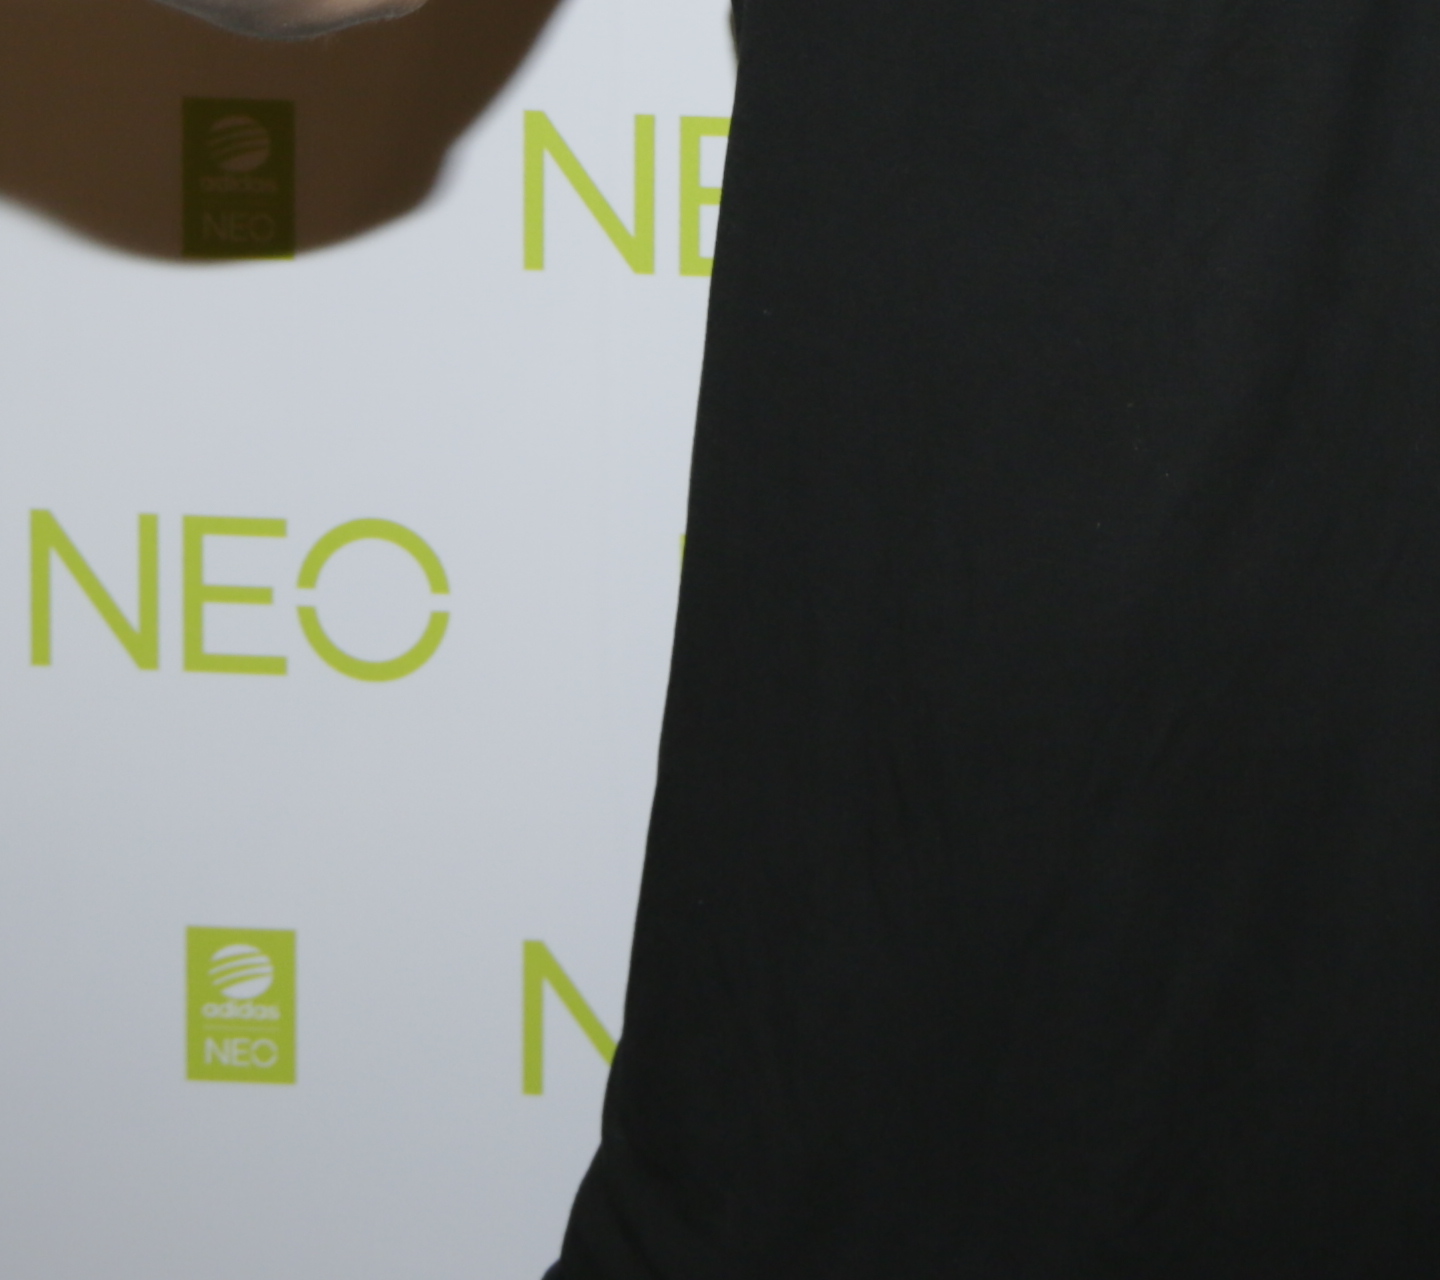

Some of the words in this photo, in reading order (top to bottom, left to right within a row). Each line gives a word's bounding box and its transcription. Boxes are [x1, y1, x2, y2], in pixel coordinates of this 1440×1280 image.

[523, 109, 734, 278] NE
[31, 510, 449, 682] NEO
[201, 999, 279, 1021] adidas
[204, 1036, 277, 1068] NEO
